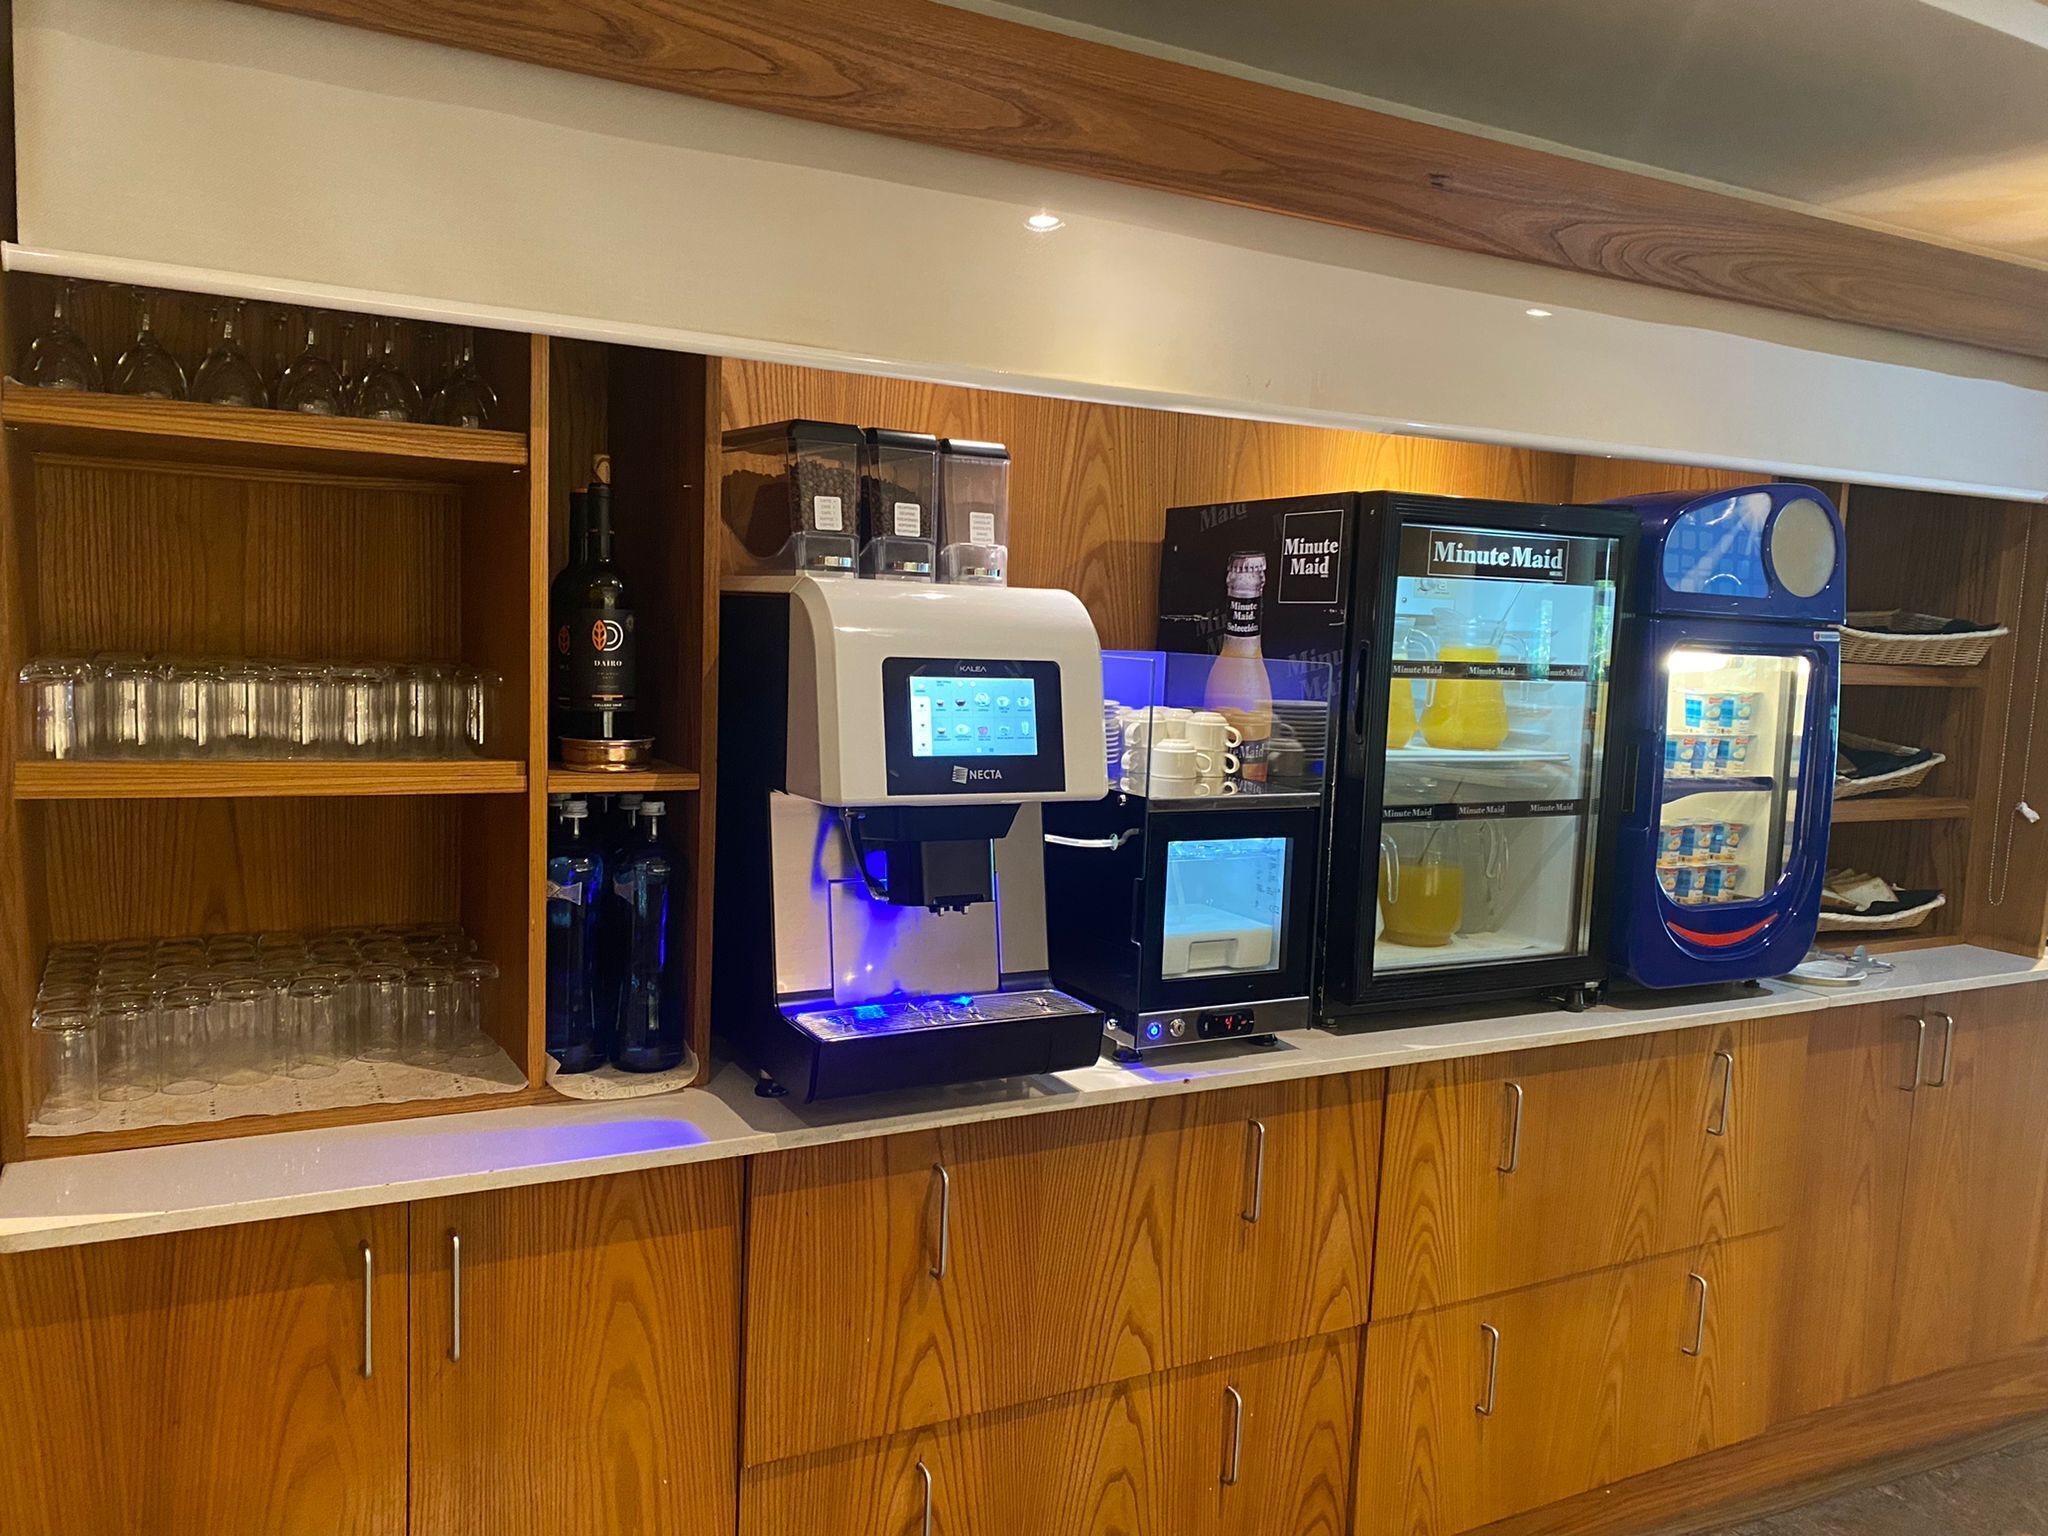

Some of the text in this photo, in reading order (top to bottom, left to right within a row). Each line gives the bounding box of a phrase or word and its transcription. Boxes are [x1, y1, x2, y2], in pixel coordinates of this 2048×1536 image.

[1284, 538, 1339, 556] Minute
[1433, 540, 1564, 570] Minute Maid
[1290, 555, 1330, 576] Maid
[1229, 600, 1258, 611] Minute
[1392, 665, 1443, 674] Minute Maid
[1469, 666, 1516, 676] Minute Maid
[969, 769, 1003, 780] NECTA
[1383, 808, 1433, 817] Minute Maid
[1458, 805, 1506, 815] Minute Maid
[1530, 803, 1574, 812] Minute Maid
